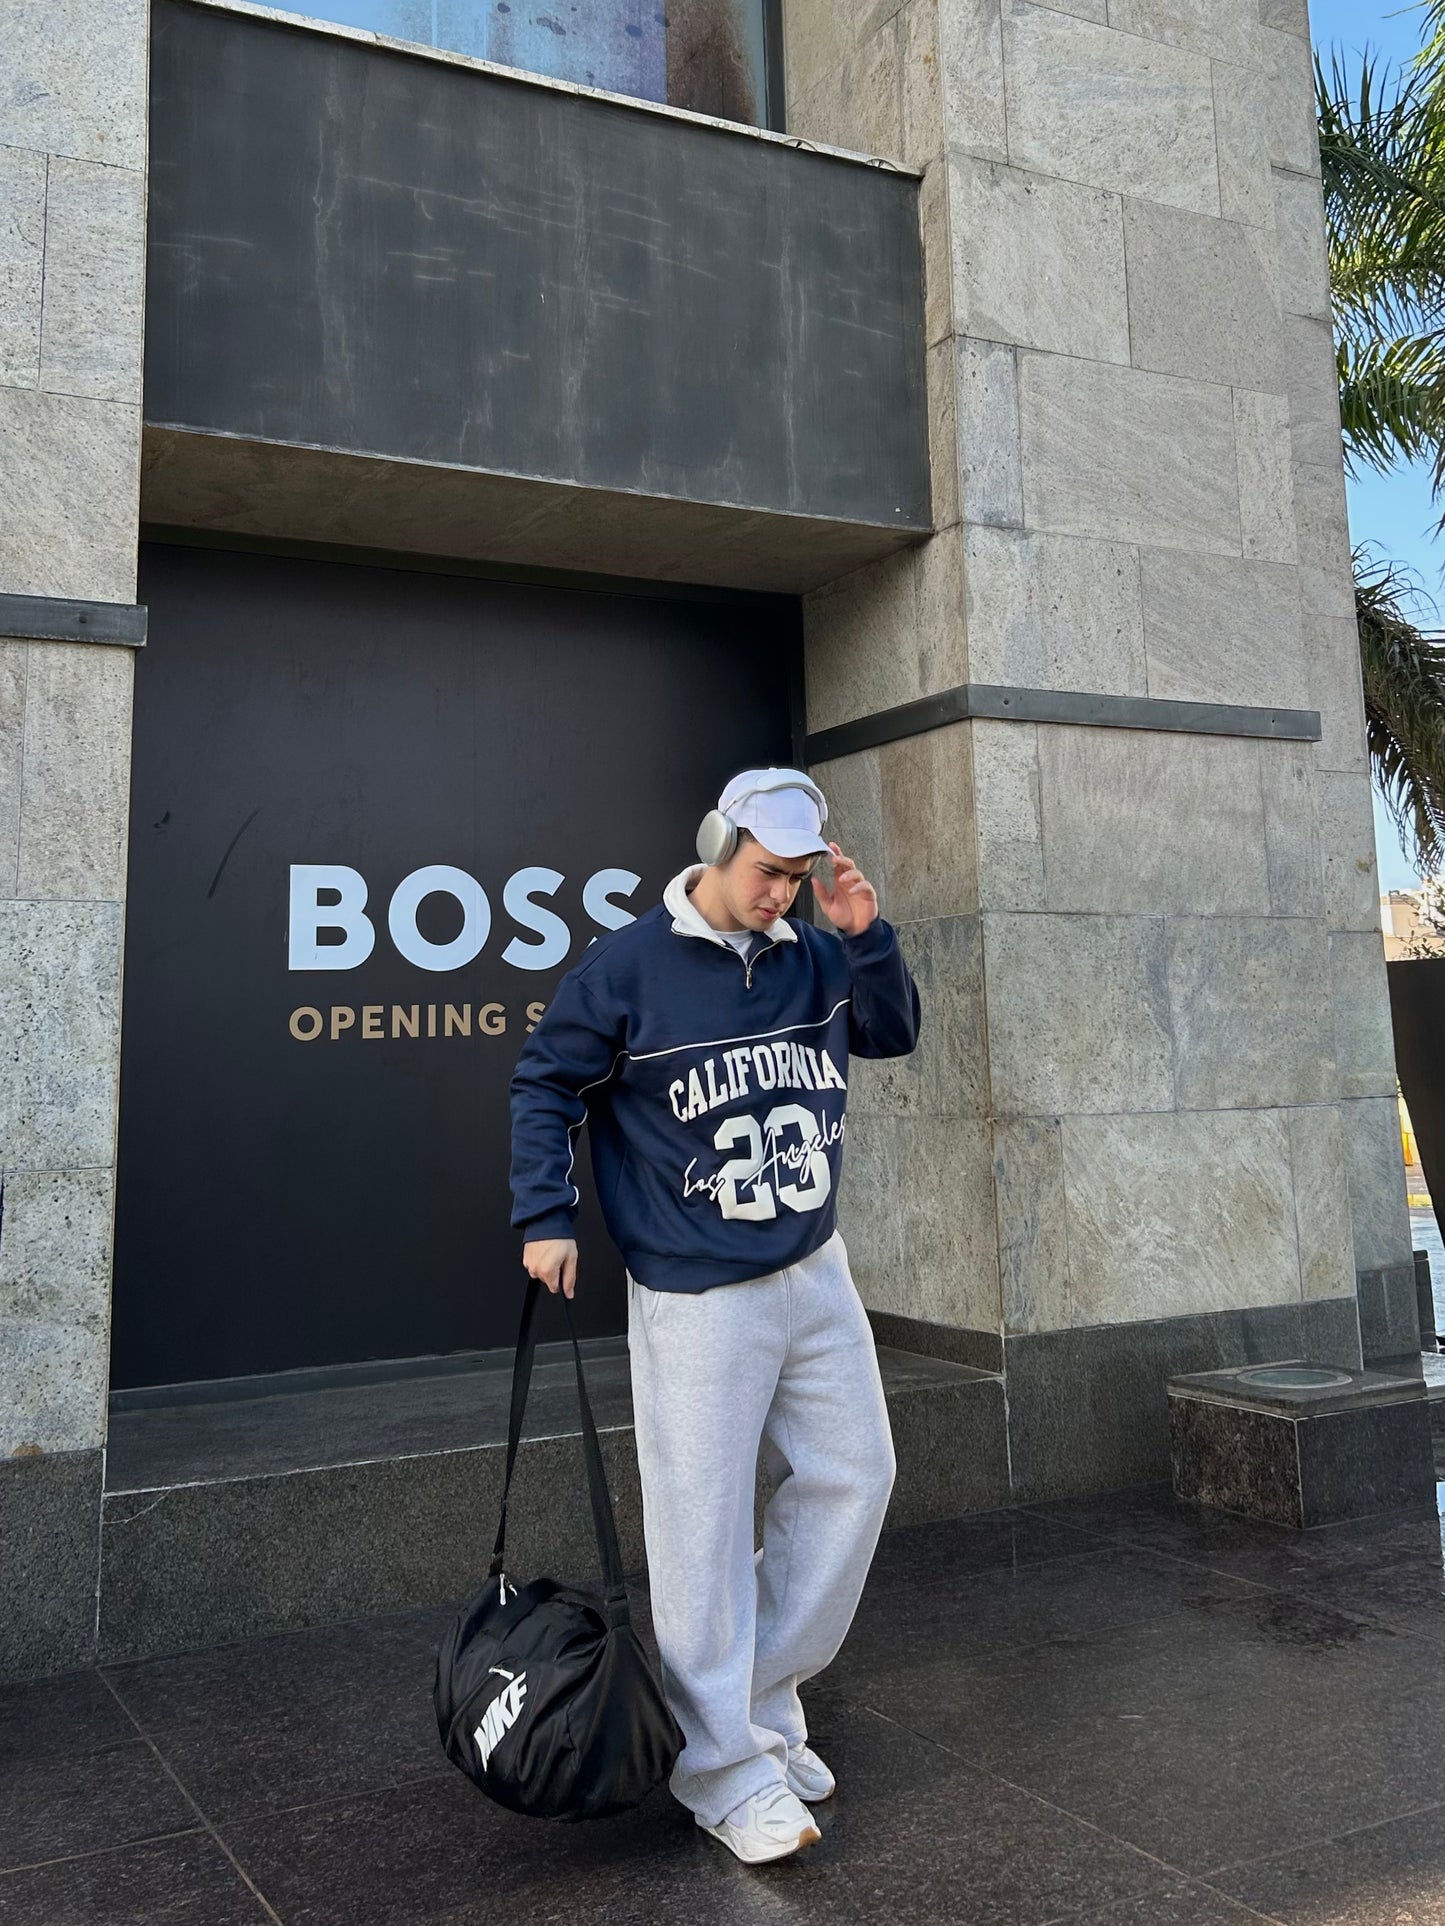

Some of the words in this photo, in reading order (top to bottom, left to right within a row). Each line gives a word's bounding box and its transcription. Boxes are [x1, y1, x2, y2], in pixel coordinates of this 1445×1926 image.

[288, 864, 642, 971] BOSS
[289, 1003, 506, 1041] OPENING
[668, 1041, 847, 1122] CALIFORNIA
[683, 1157, 726, 1202] Los
[713, 1103, 831, 1221] 23
[473, 1671, 527, 1773] NIKE
